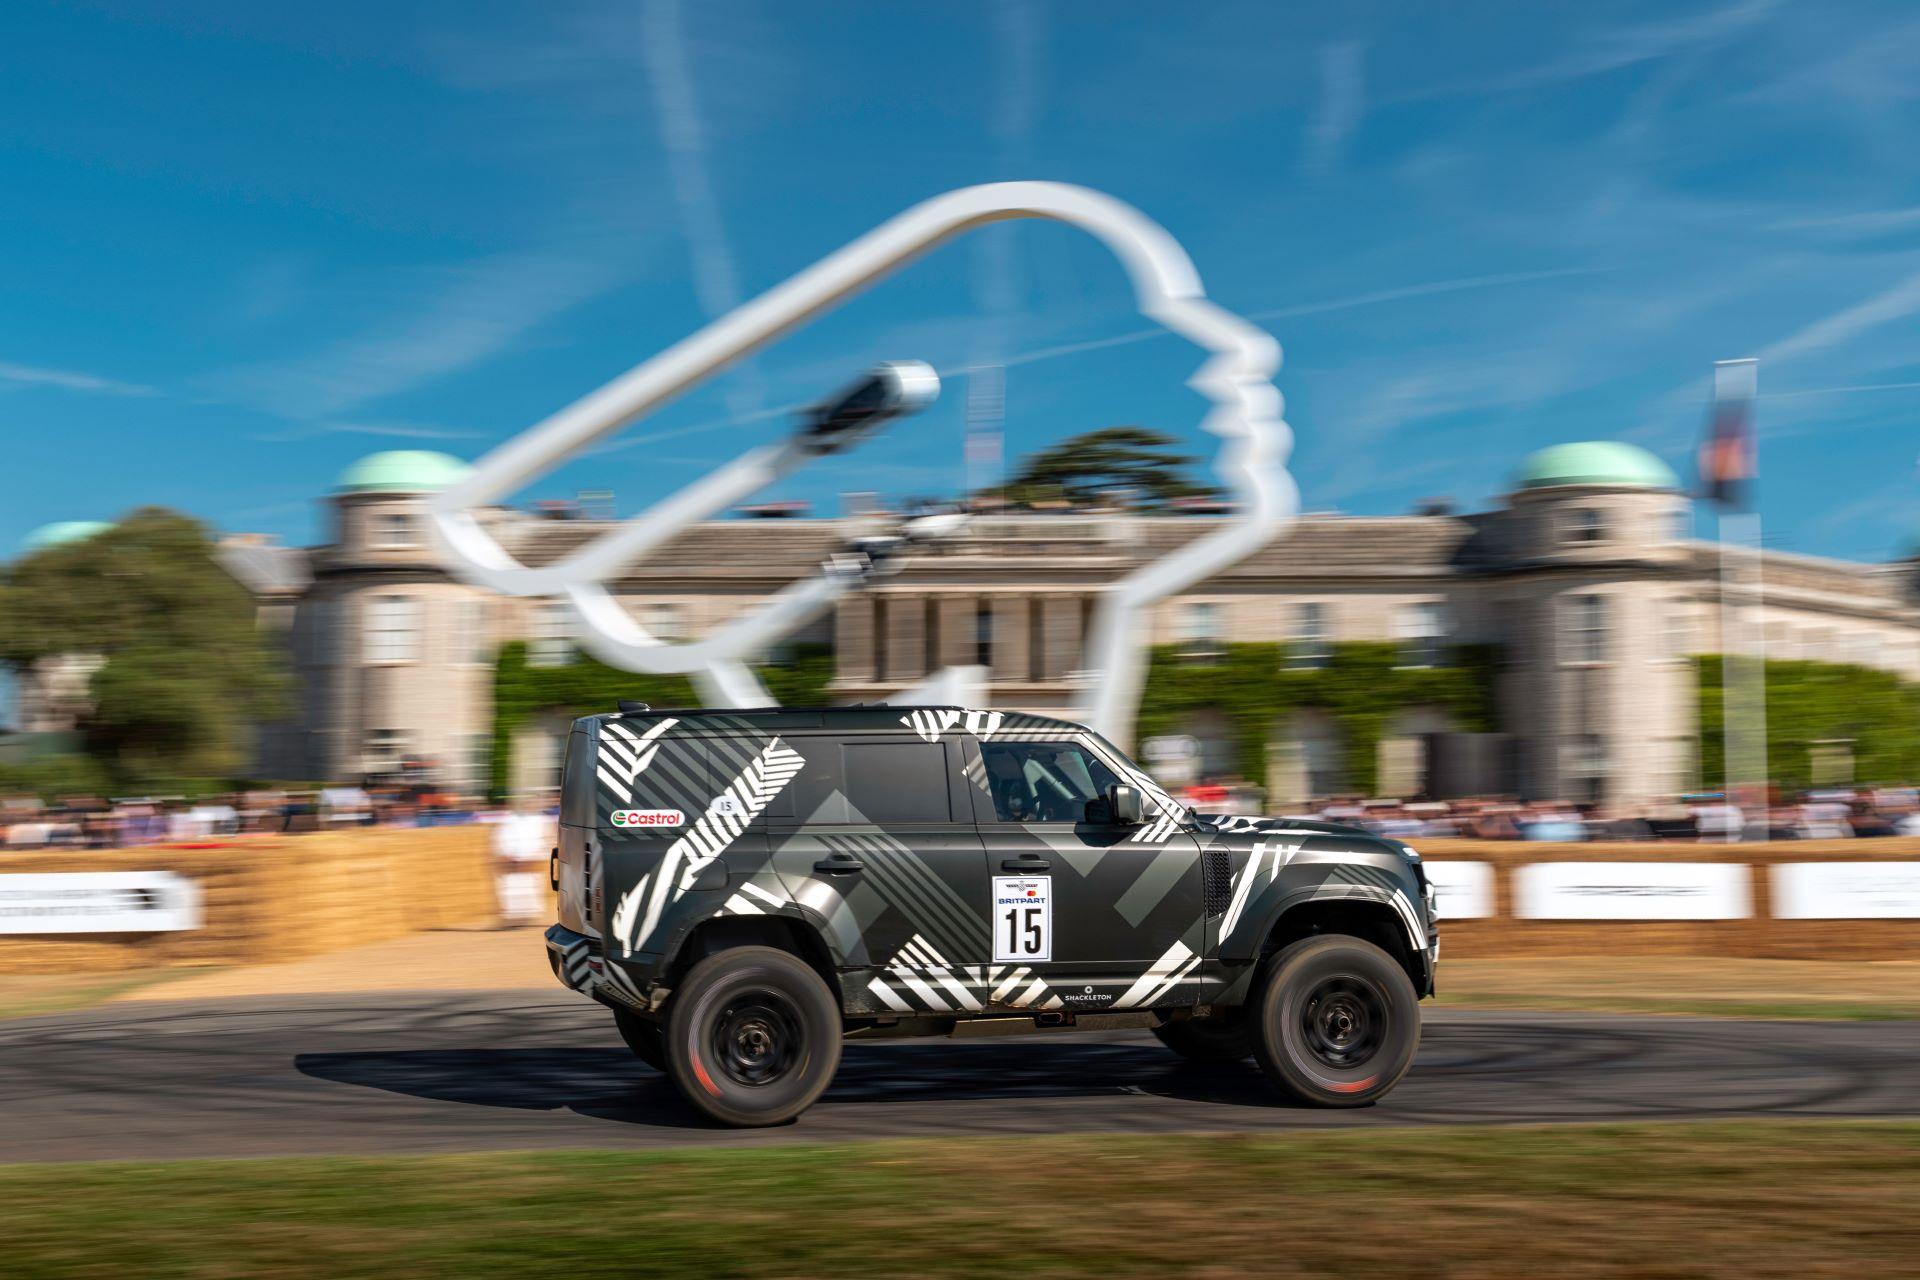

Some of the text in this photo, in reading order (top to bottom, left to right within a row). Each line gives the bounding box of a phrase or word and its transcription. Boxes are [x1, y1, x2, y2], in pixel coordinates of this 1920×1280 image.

[720, 801, 732, 811] 15
[628, 813, 680, 824] Castrol
[1005, 908, 1042, 954] 15
